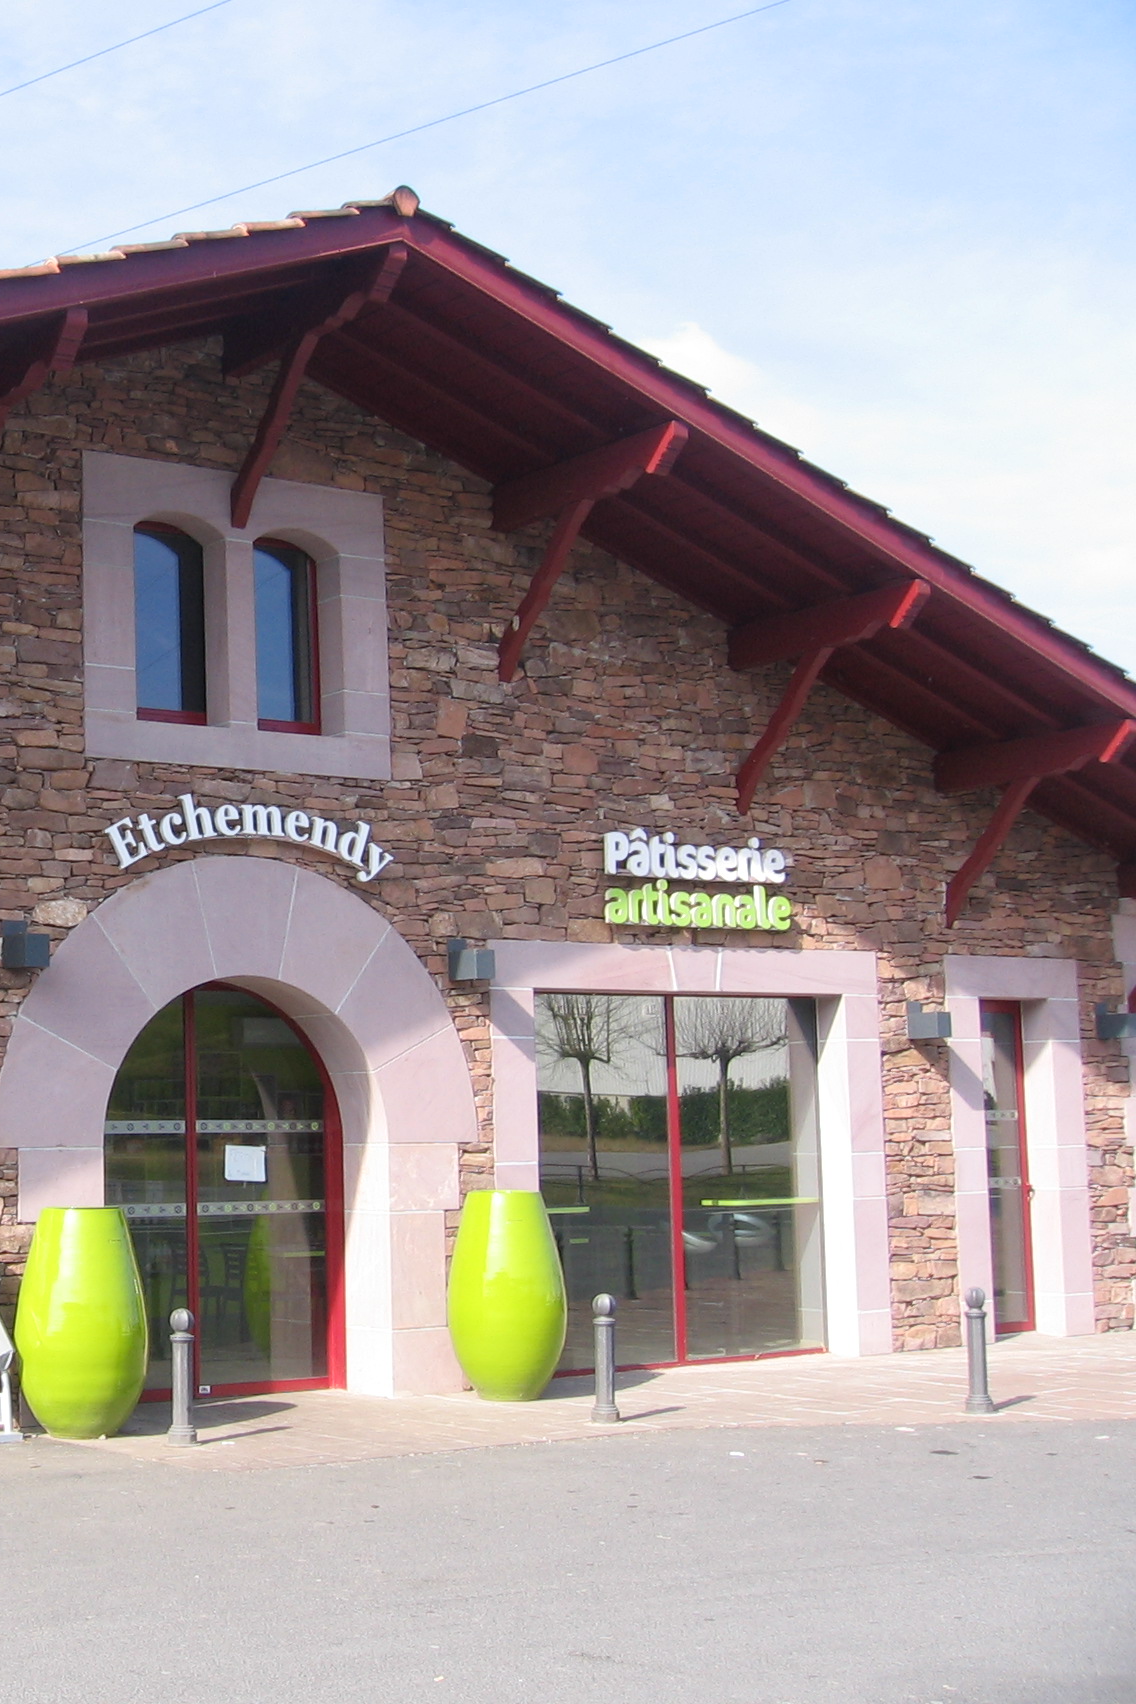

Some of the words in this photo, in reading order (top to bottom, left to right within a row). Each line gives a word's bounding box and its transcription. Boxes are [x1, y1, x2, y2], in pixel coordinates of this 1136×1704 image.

[104, 793, 394, 883] Etchemendy
[604, 827, 787, 884] Pâtisserie
[604, 879, 791, 931] artisanale
